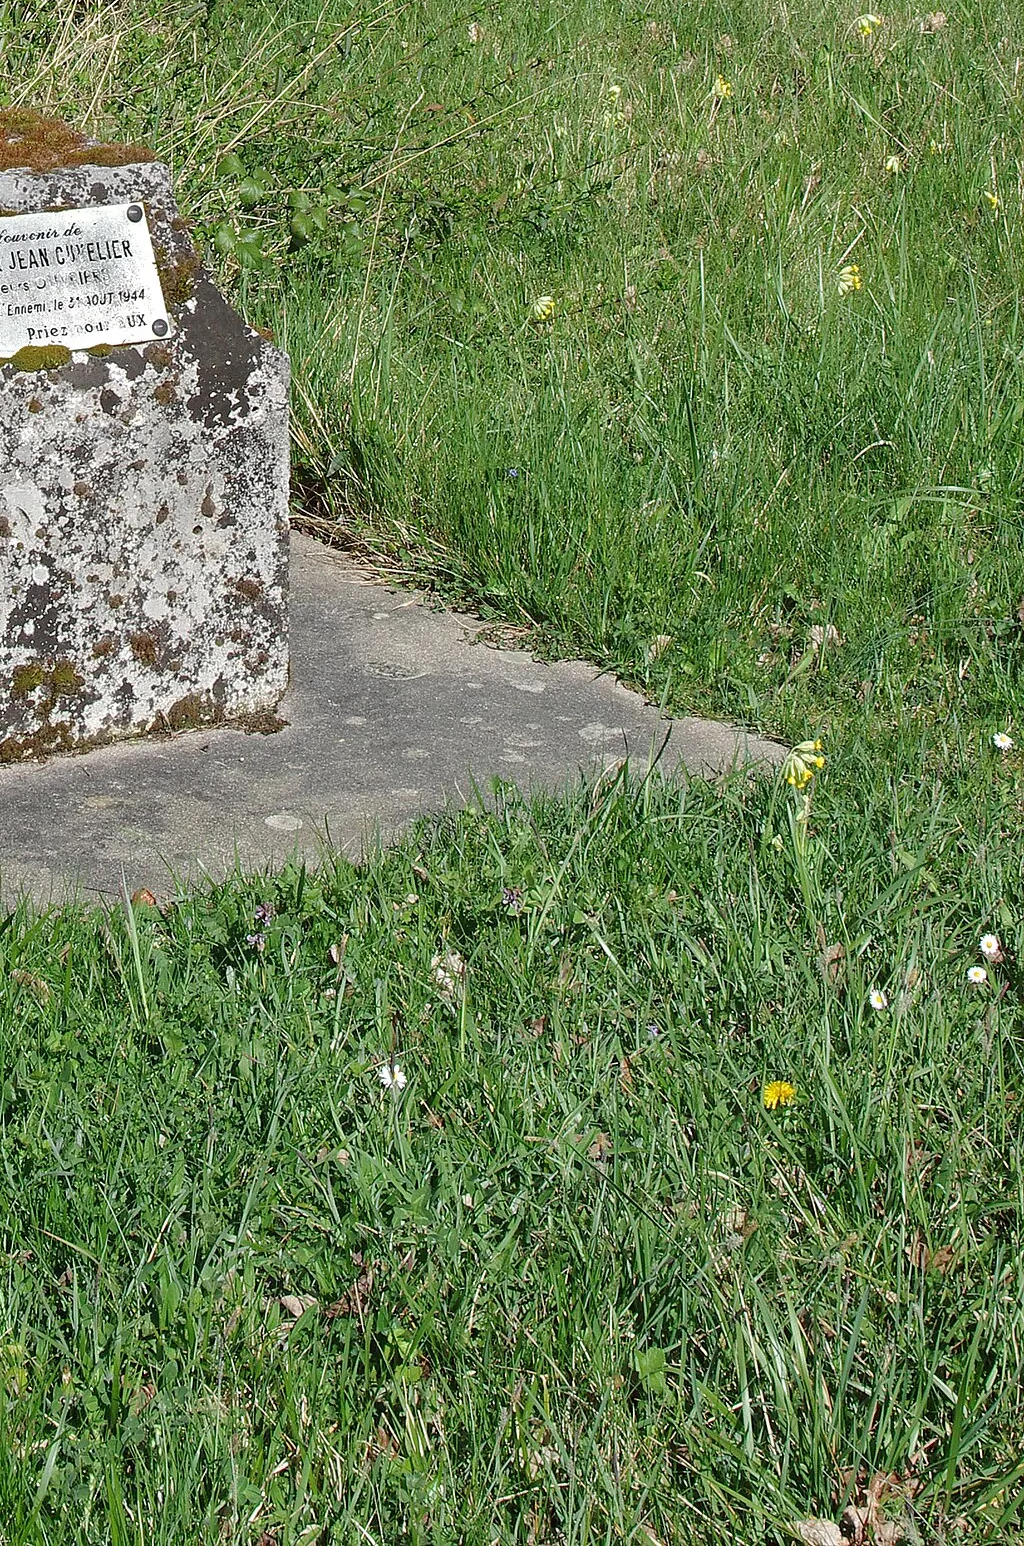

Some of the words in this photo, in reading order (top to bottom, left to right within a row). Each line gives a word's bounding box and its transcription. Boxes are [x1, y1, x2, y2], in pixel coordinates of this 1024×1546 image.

[63, 222, 83, 236] de
[9, 248, 50, 270] JEAN
[55, 240, 133, 265] CUVELIER
[36, 267, 110, 289] ORIERS
[54, 299, 63, 310] le
[118, 288, 145, 302] 1944
[27, 325, 68, 340] Priez
